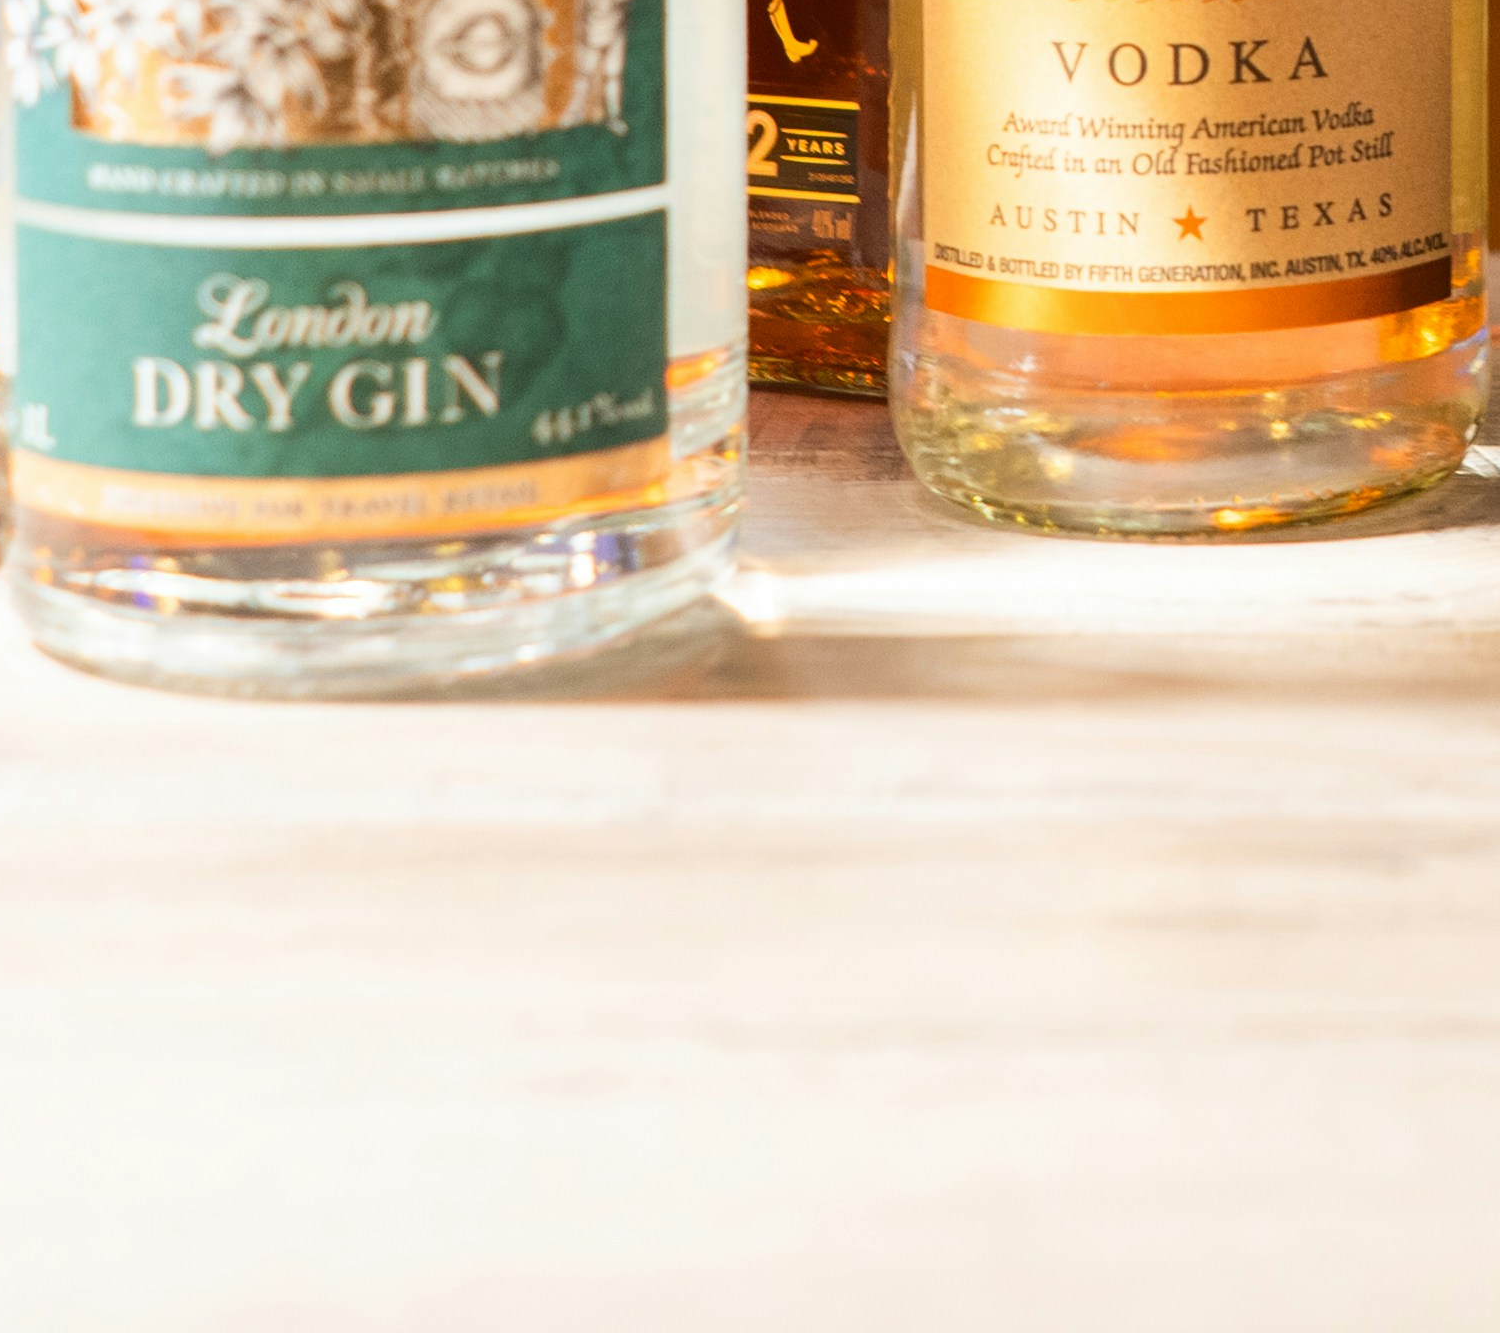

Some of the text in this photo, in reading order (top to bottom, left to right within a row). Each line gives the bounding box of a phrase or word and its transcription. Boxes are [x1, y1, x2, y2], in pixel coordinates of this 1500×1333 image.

[1051, 35, 1329, 88] VODKA
[786, 137, 847, 156] YEARS
[1002, 101, 1376, 153] Award Winning American Vodka
[986, 131, 1396, 179] Crafted in an Old Fashioned Pot Still
[158, 166, 287, 199] CRAFTED
[292, 169, 328, 197] IN
[331, 164, 427, 195] SMALL
[988, 192, 1394, 235] AUSTIN TEXAS
[933, 242, 984, 270] DISTILLED
[987, 255, 997, 271] &
[999, 257, 1060, 280] BOTTLED
[1064, 263, 1084, 280] BY
[1089, 264, 1133, 283] FIFTH
[193, 271, 434, 358] London
[131, 350, 506, 433] DRY GIN
